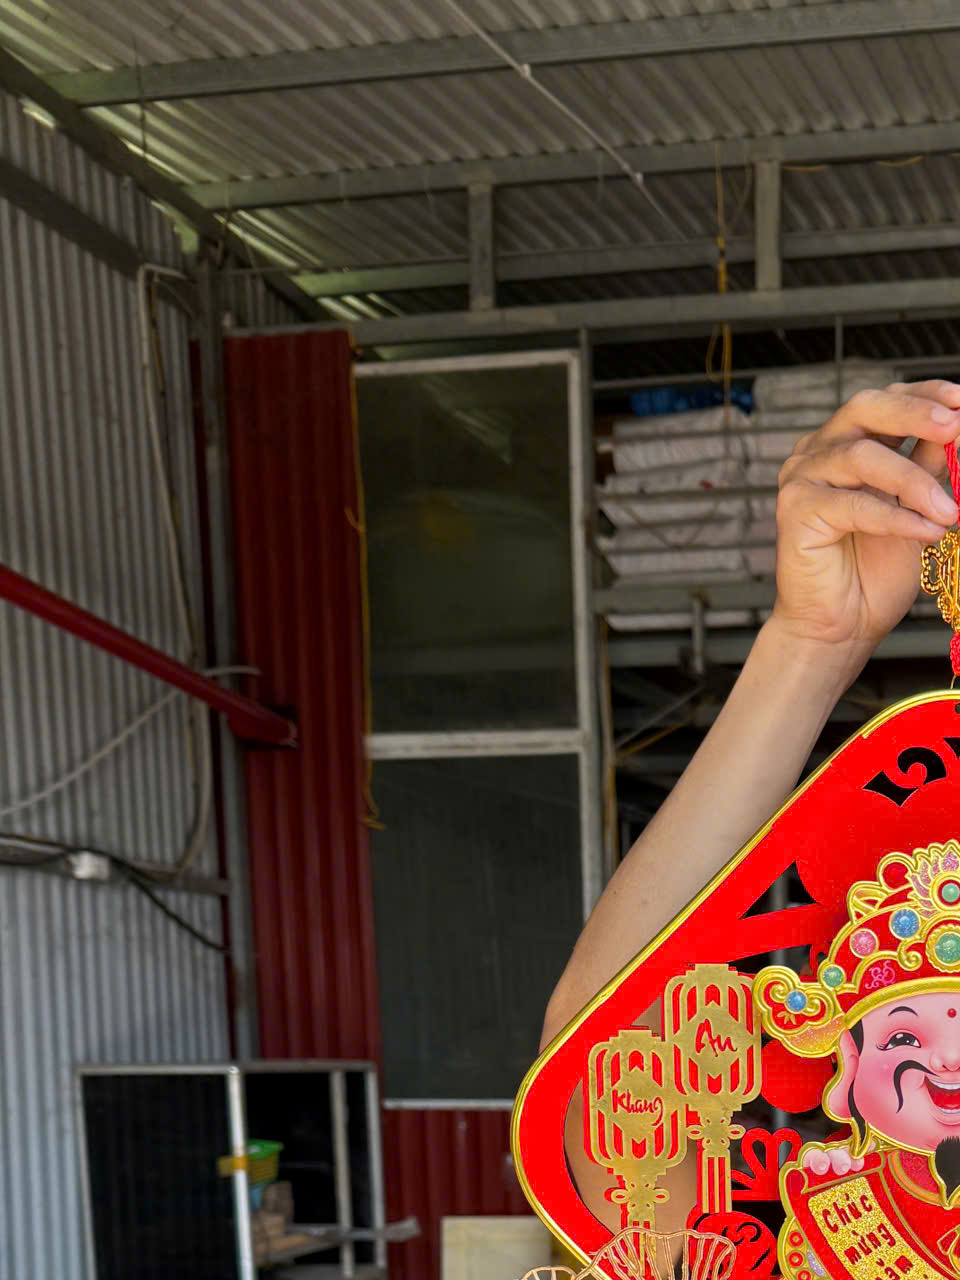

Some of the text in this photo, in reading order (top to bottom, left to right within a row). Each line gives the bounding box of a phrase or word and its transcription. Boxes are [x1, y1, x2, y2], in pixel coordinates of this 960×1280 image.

[695, 1018, 737, 1058] An
[611, 1088, 664, 1127] Khang
[822, 1192, 873, 1234] Chúc
[844, 1222, 897, 1265] mừng
